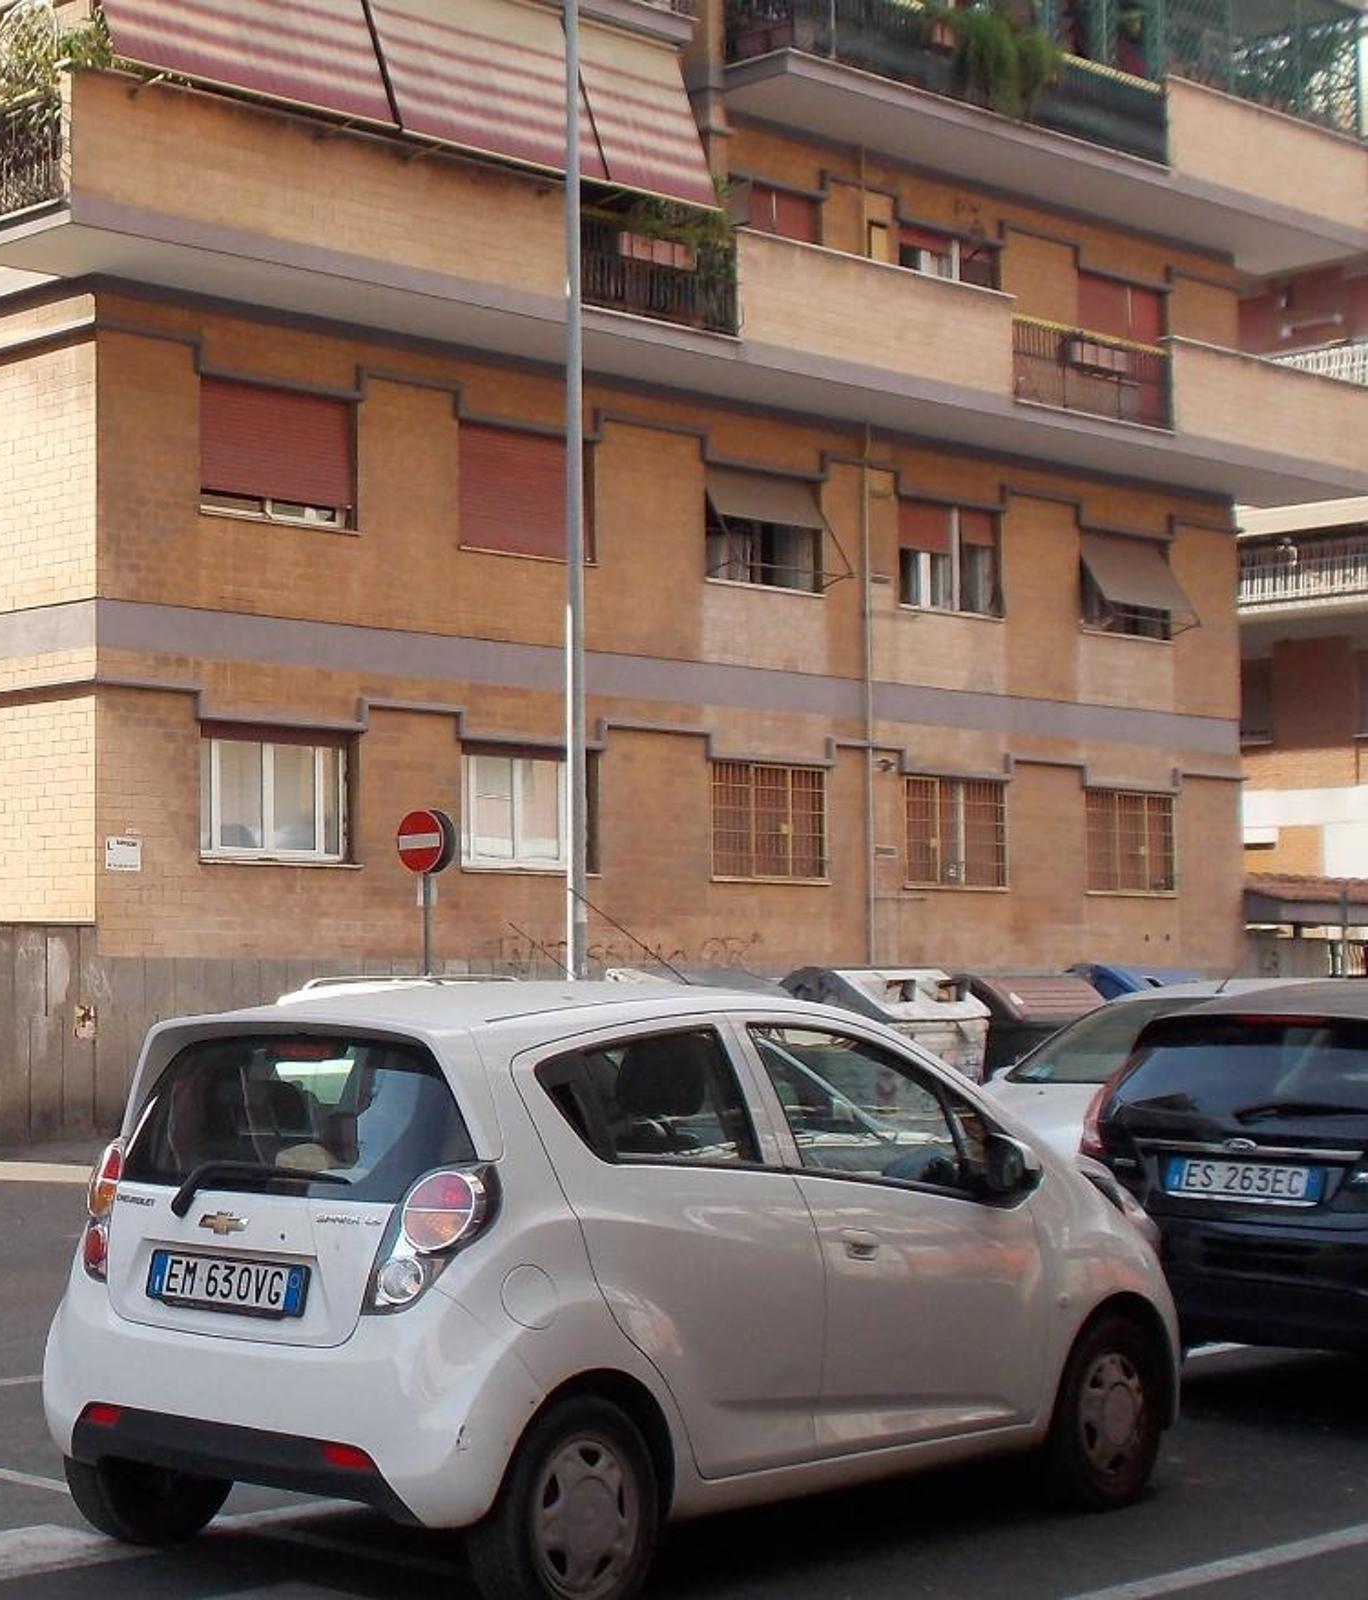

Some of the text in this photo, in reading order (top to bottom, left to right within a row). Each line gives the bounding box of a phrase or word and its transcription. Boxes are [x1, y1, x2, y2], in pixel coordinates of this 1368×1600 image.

[1185, 1162, 1216, 1188] ES
[1223, 1165, 1304, 1197] 263EC
[165, 1258, 199, 1296] EM
[205, 1263, 284, 1306] 630VG
